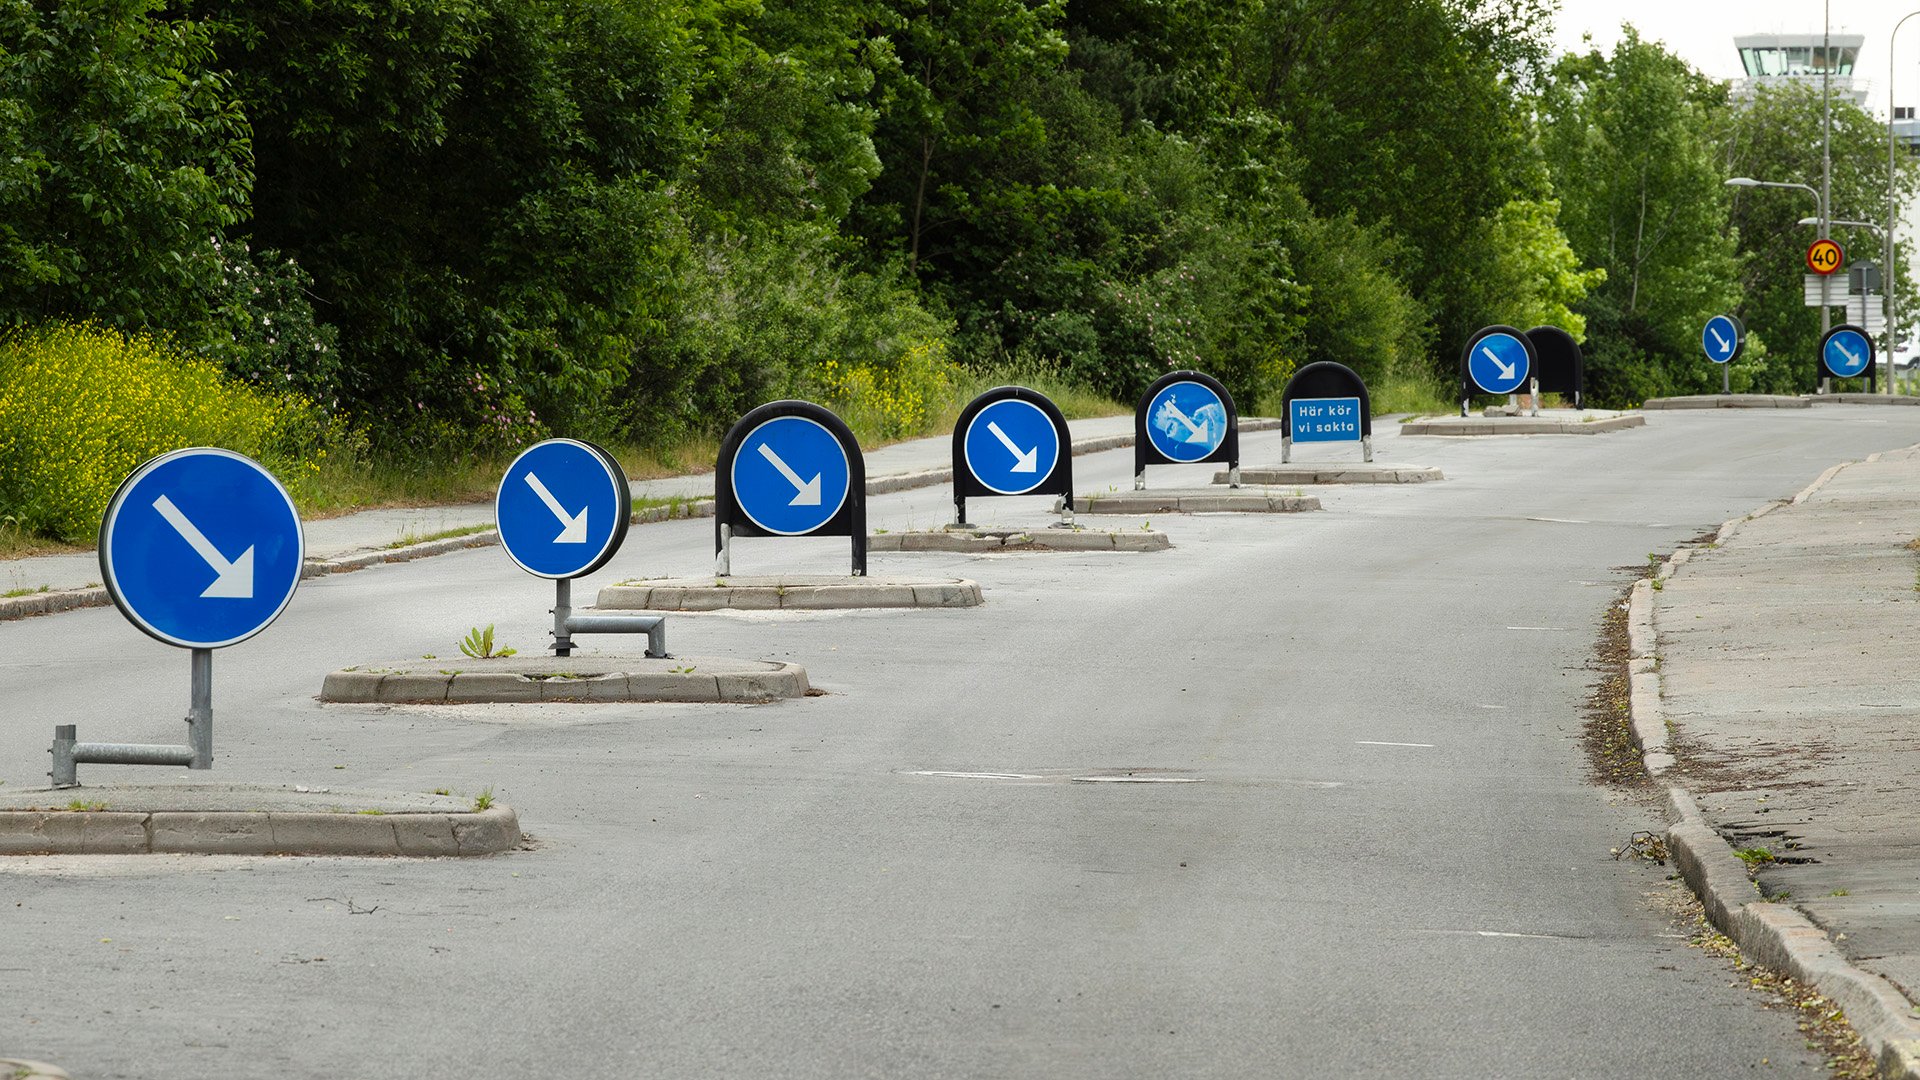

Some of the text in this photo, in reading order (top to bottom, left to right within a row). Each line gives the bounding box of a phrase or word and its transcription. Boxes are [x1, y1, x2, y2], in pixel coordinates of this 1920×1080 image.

[1812, 249, 1837, 266] 40
[1299, 405, 1352, 417] Här kör
[1298, 421, 1354, 433] vi sakta
